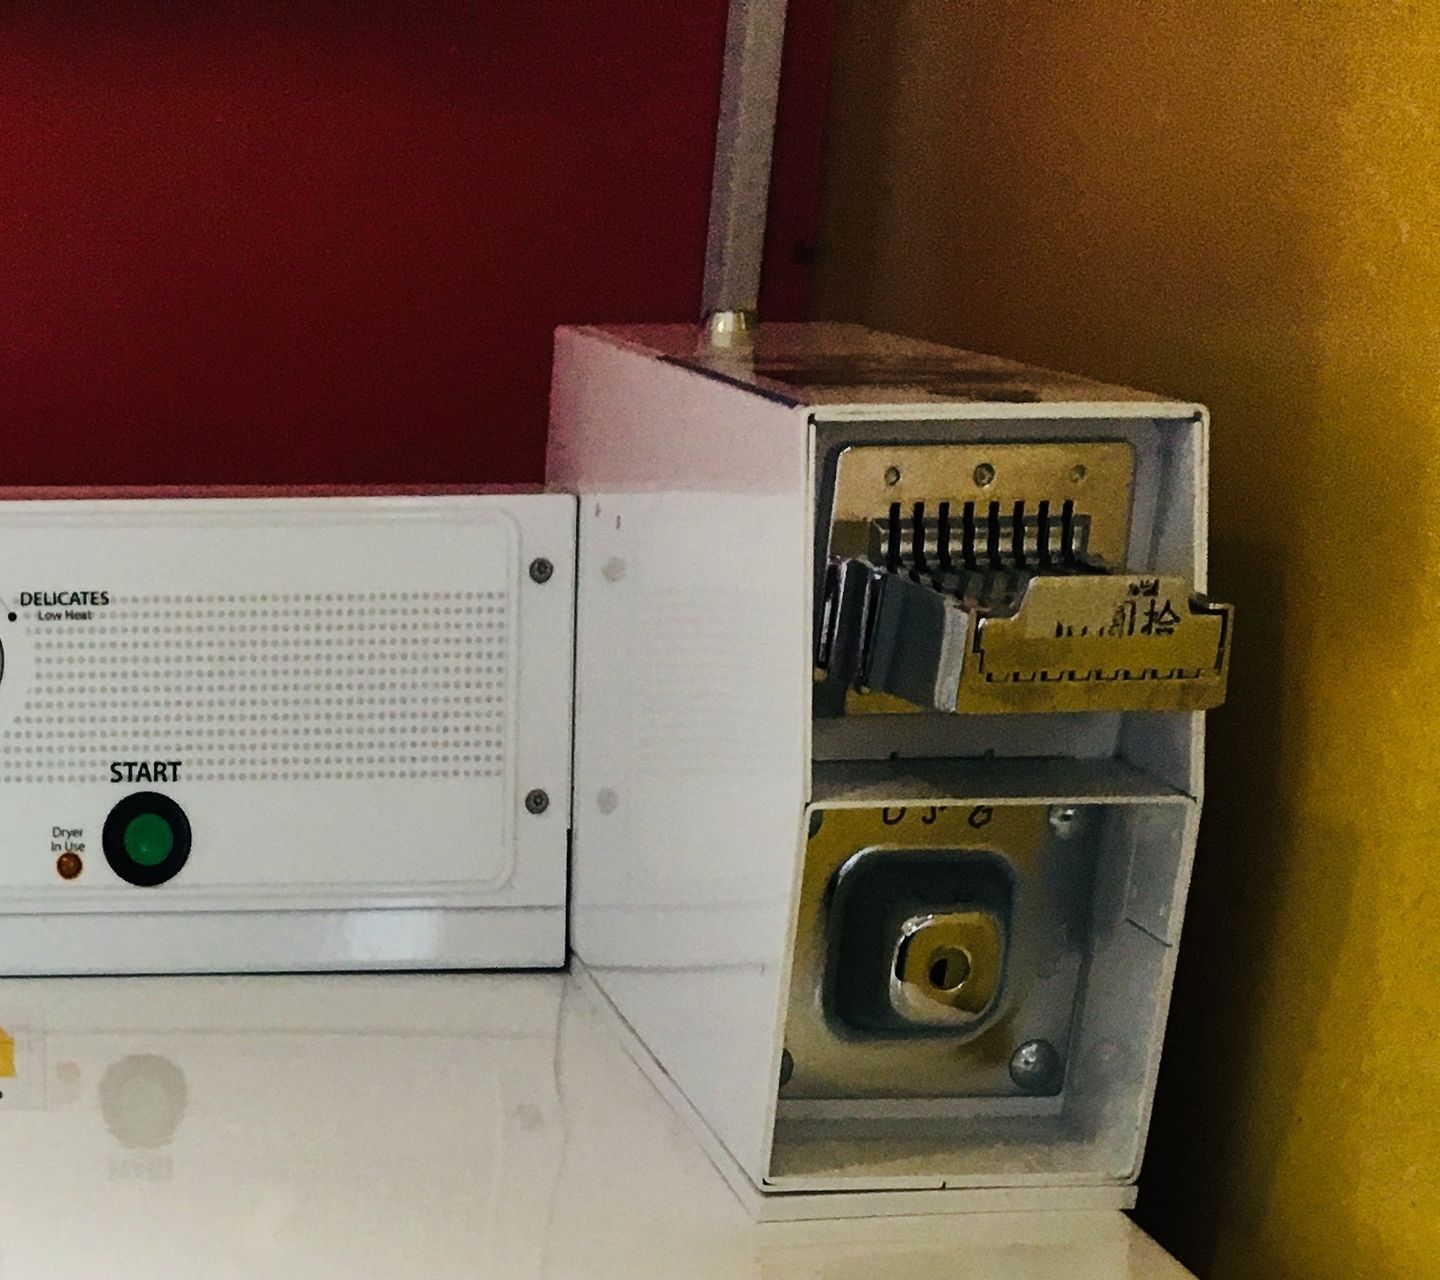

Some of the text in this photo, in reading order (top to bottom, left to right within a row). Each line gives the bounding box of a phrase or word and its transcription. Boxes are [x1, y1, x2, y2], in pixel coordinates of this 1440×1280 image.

[19, 590, 110, 607] DELICATES
[37, 609, 93, 621] Low Heat
[110, 760, 182, 783] START
[52, 826, 84, 841] Dryer
[51, 840, 86, 853] In Use
